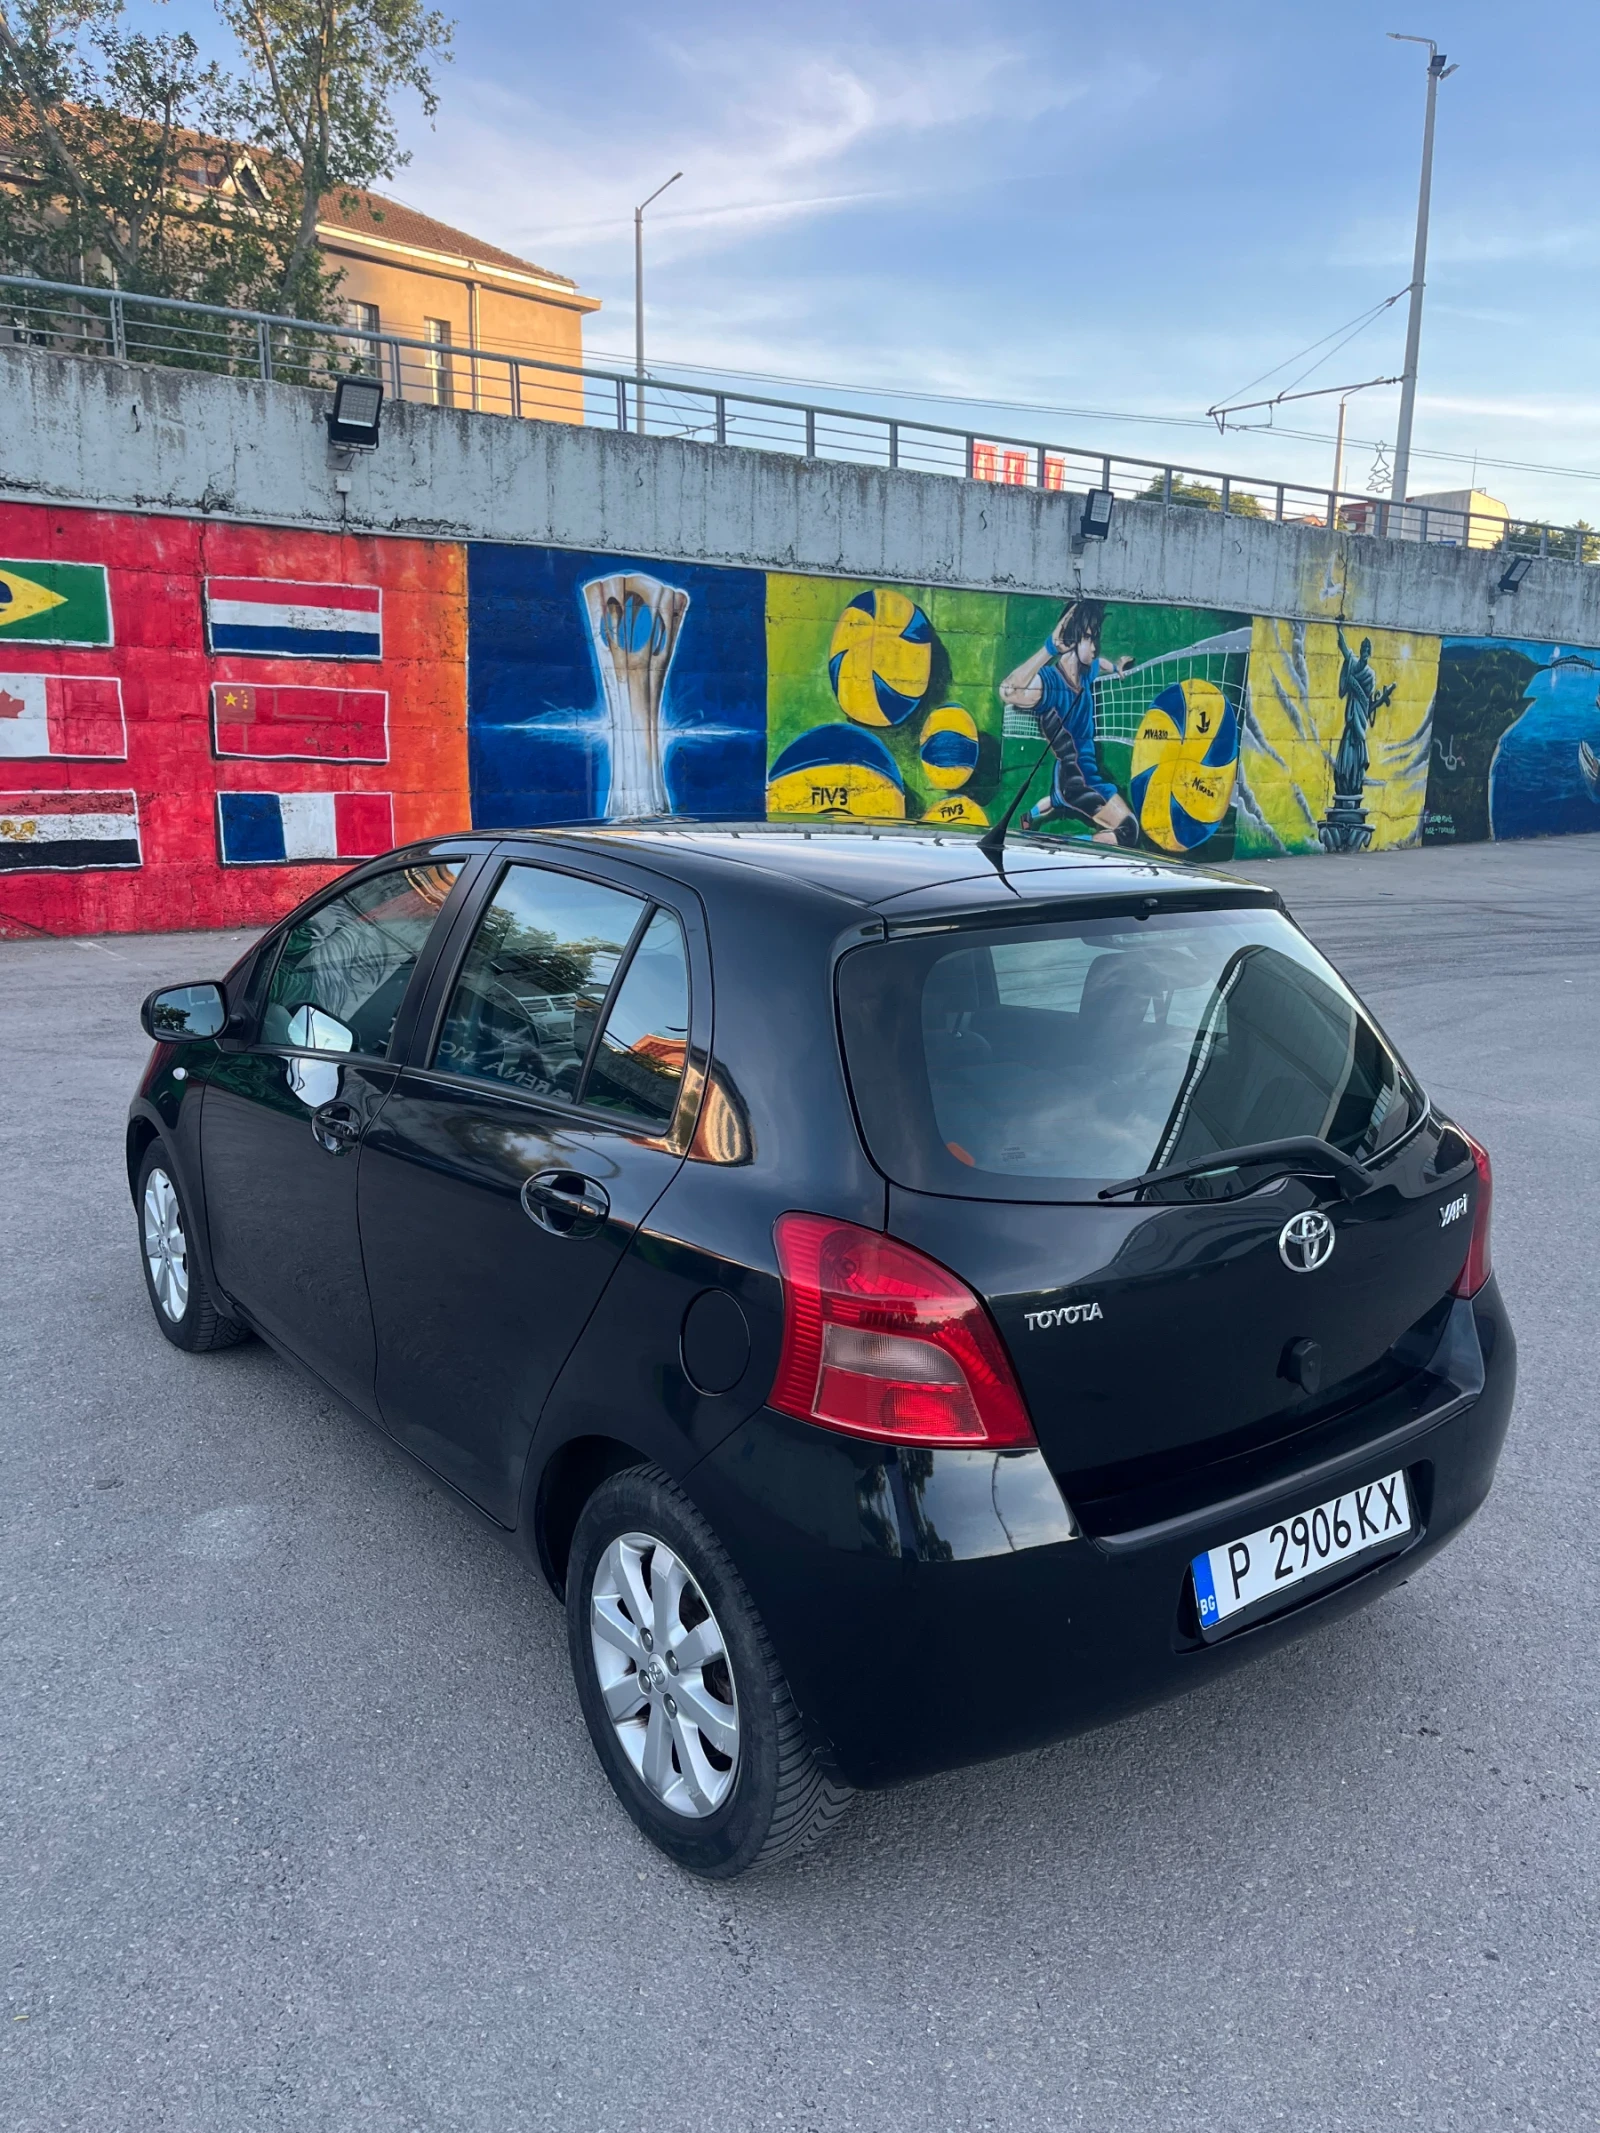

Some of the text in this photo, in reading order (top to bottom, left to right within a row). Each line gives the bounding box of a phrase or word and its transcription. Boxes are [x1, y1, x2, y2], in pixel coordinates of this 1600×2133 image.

[1024, 1302, 1104, 1331] TOYOTA
[1227, 1476, 1403, 1600] P 2906 KX
[1199, 1595, 1216, 1616] BG
